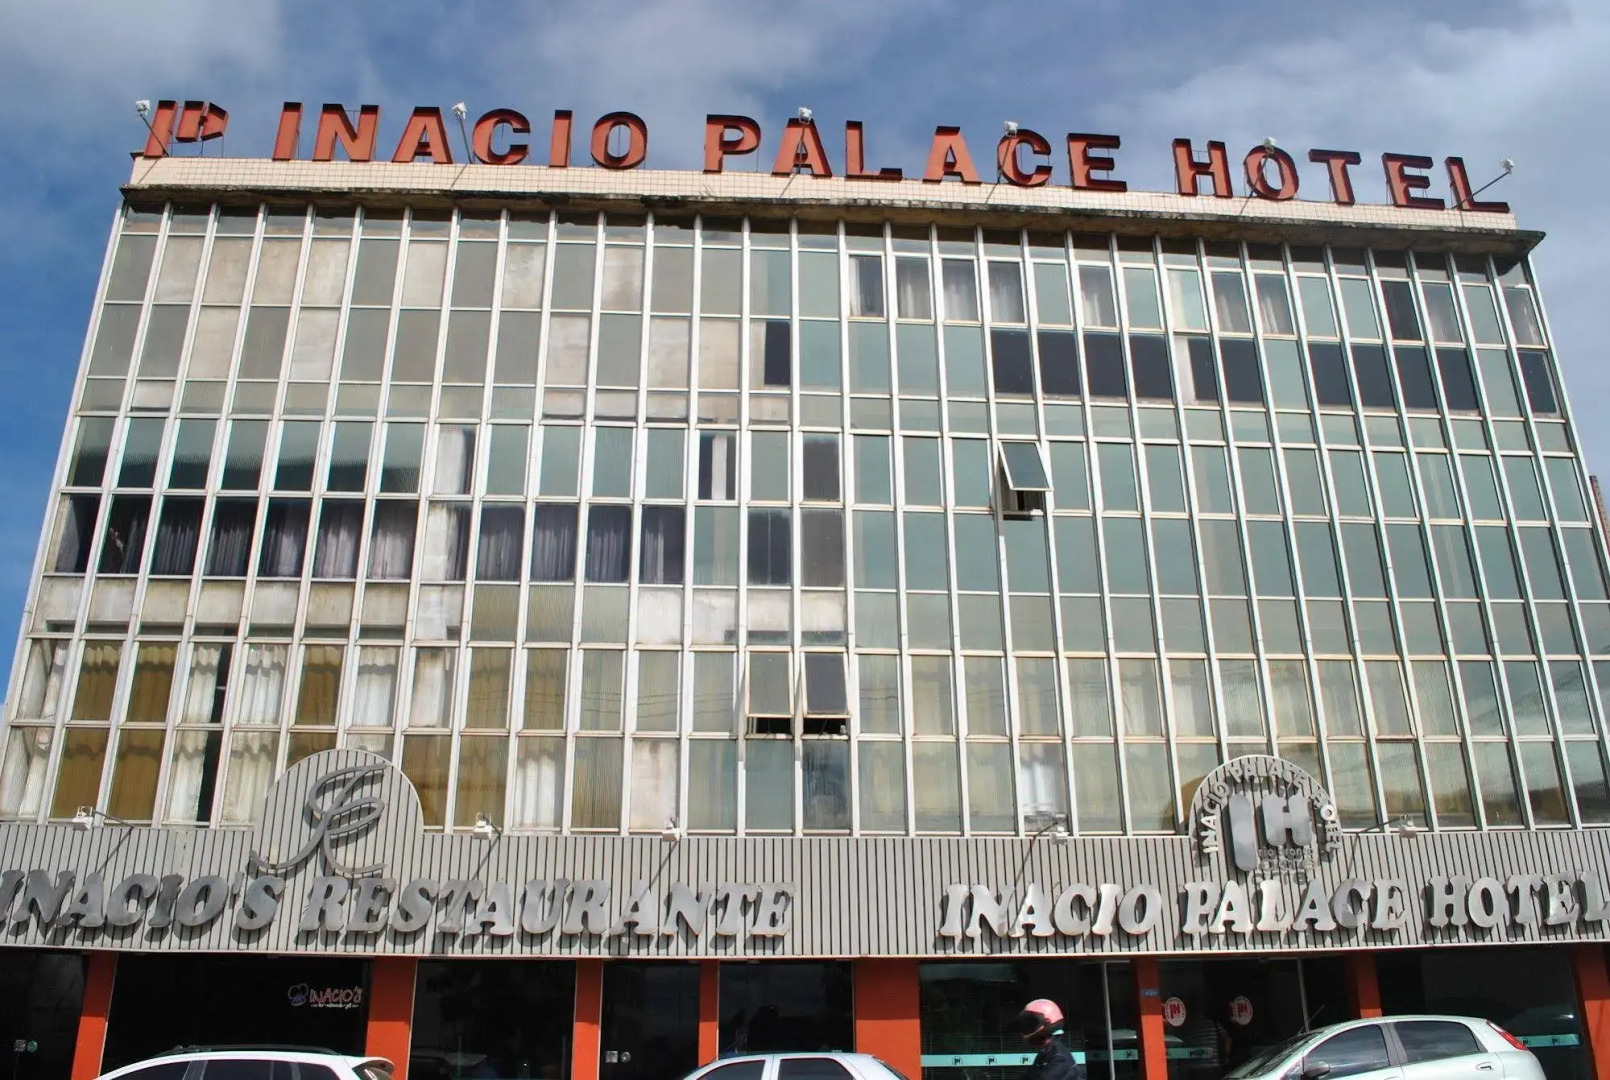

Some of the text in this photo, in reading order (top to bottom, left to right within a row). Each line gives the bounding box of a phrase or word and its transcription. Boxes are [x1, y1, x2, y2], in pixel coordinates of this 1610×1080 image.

[272, 101, 1511, 213] INACIO PALACE HOTEL
[1200, 781, 1230, 854] INACIO
[0, 869, 796, 937] INACIO'S RESTAURANTE
[938, 870, 1610, 938] INACIO PALACE HOTEL
